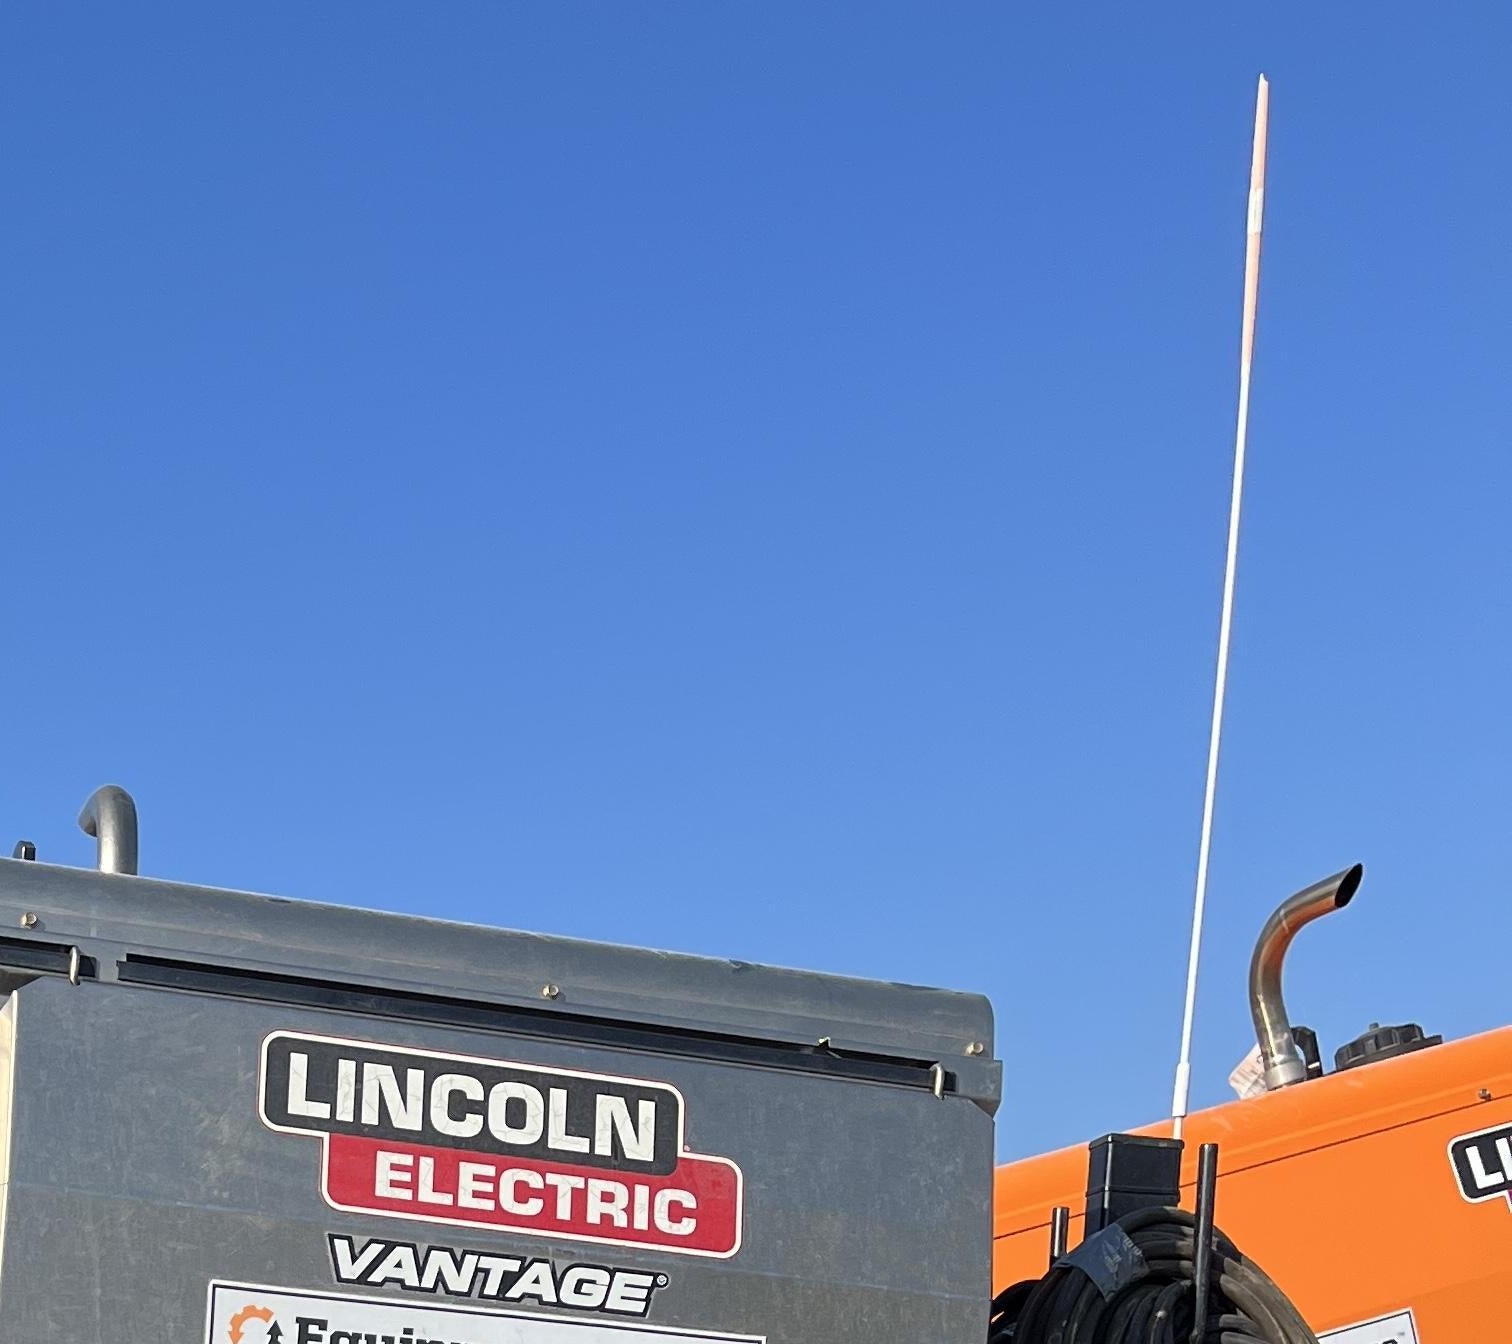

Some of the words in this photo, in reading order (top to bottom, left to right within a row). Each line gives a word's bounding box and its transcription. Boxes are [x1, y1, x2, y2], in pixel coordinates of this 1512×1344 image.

[287, 1052, 656, 1162] LINCOLN
[374, 1150, 697, 1235] ELECTRIC
[330, 1235, 654, 1316] VANTAGE
